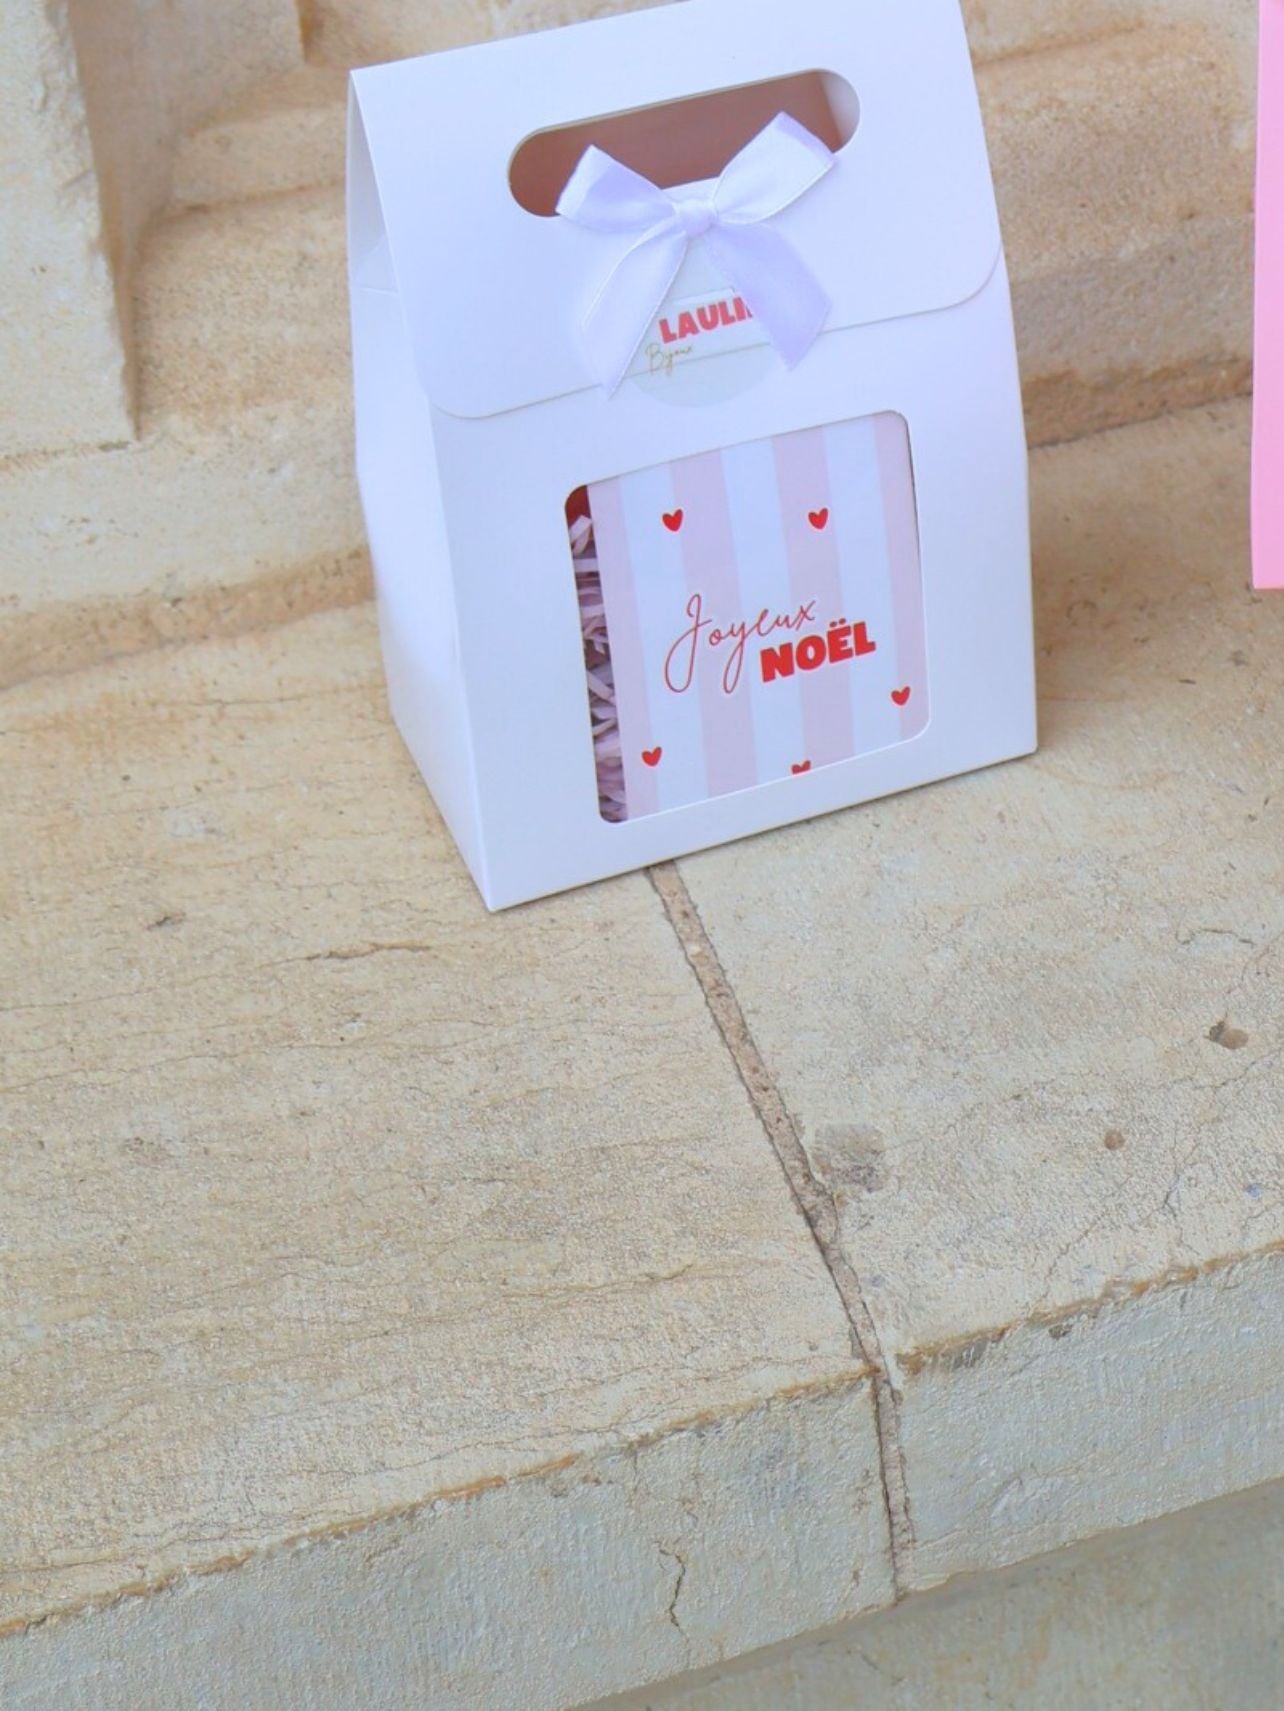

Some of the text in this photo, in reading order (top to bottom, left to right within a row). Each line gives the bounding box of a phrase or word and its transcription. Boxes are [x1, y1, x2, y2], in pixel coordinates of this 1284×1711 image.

[659, 296, 752, 343] LAULI
[664, 593, 816, 694] Joyeux
[761, 618, 876, 682] NOËL
